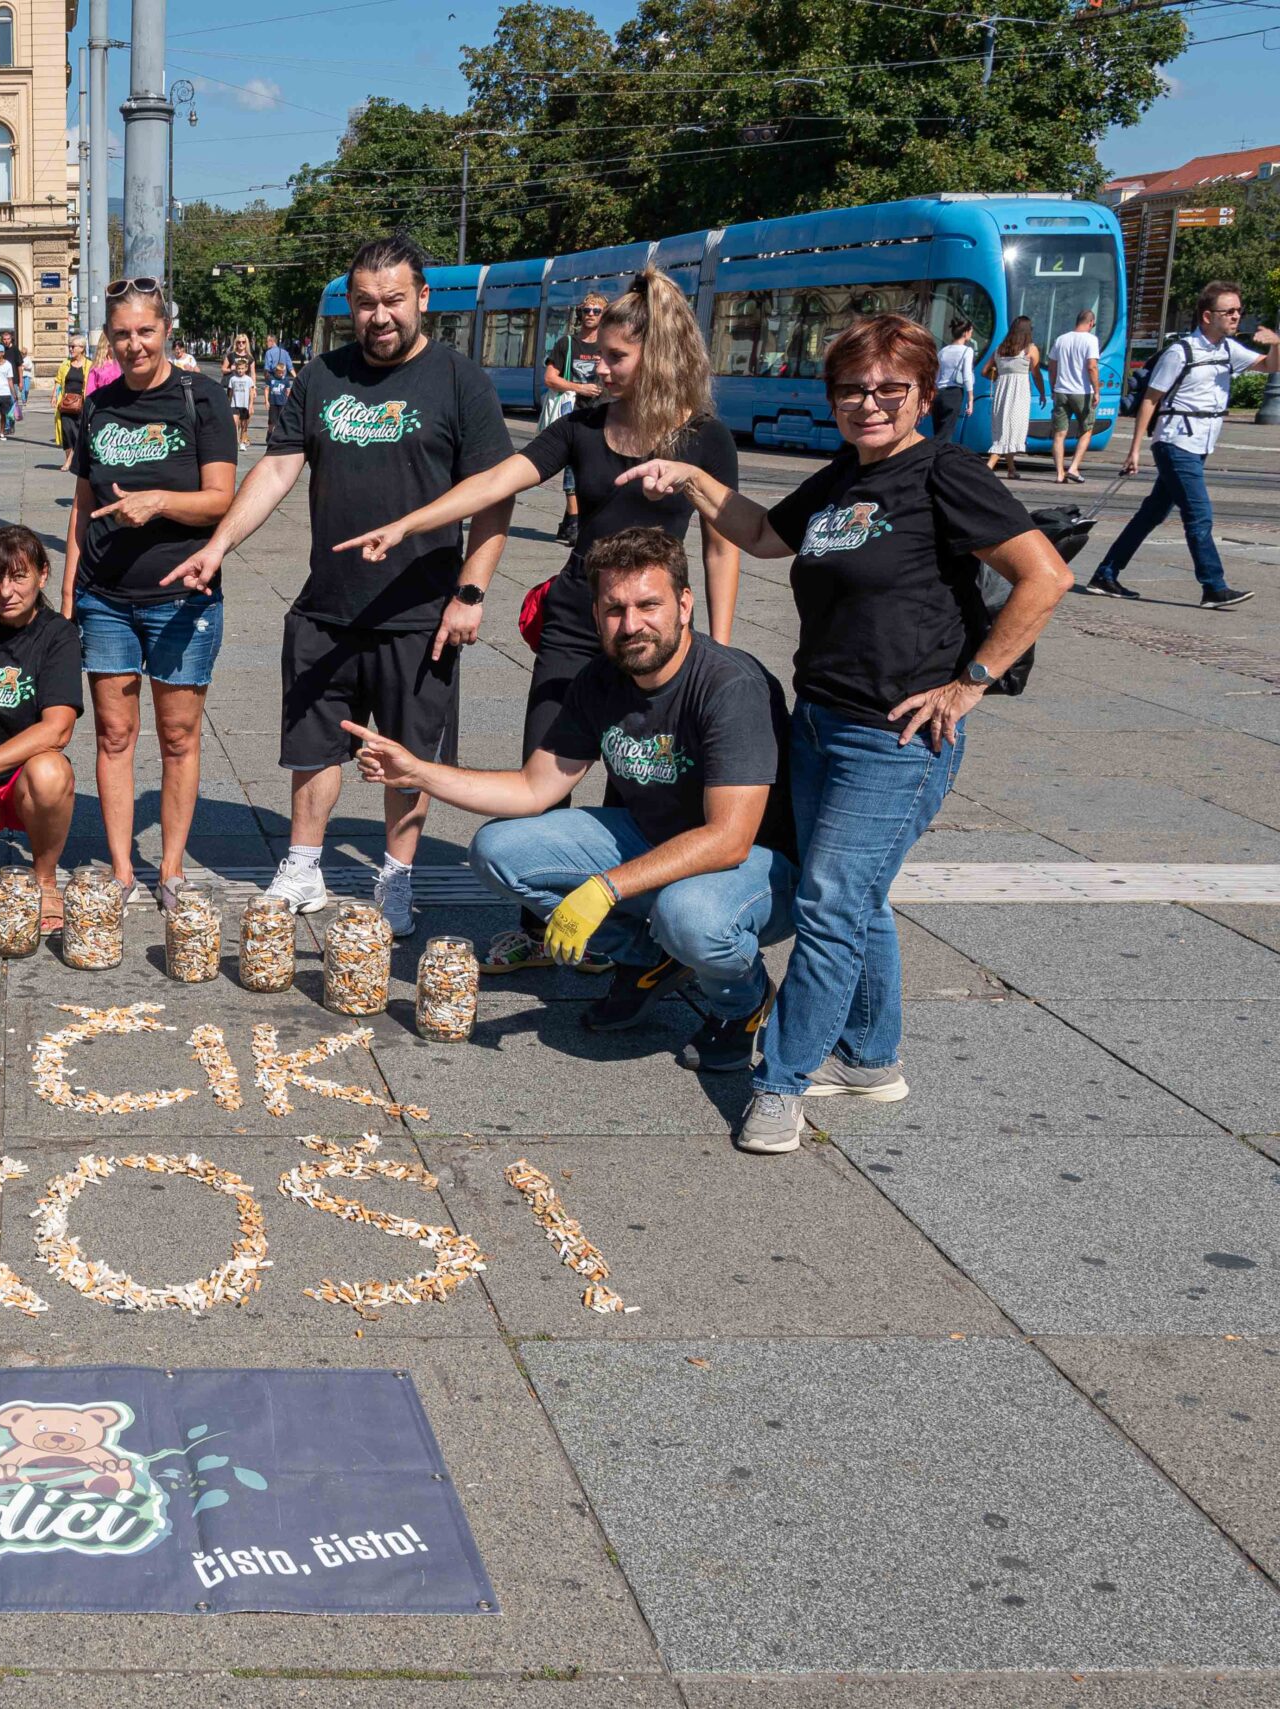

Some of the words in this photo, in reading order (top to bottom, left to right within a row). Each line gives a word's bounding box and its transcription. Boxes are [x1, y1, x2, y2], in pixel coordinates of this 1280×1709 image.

[1052, 253, 1065, 271] 2
[30, 1001, 431, 1121] ČIK
[191, 1545, 312, 1589] čisto,
[309, 1523, 430, 1569] čisto!
